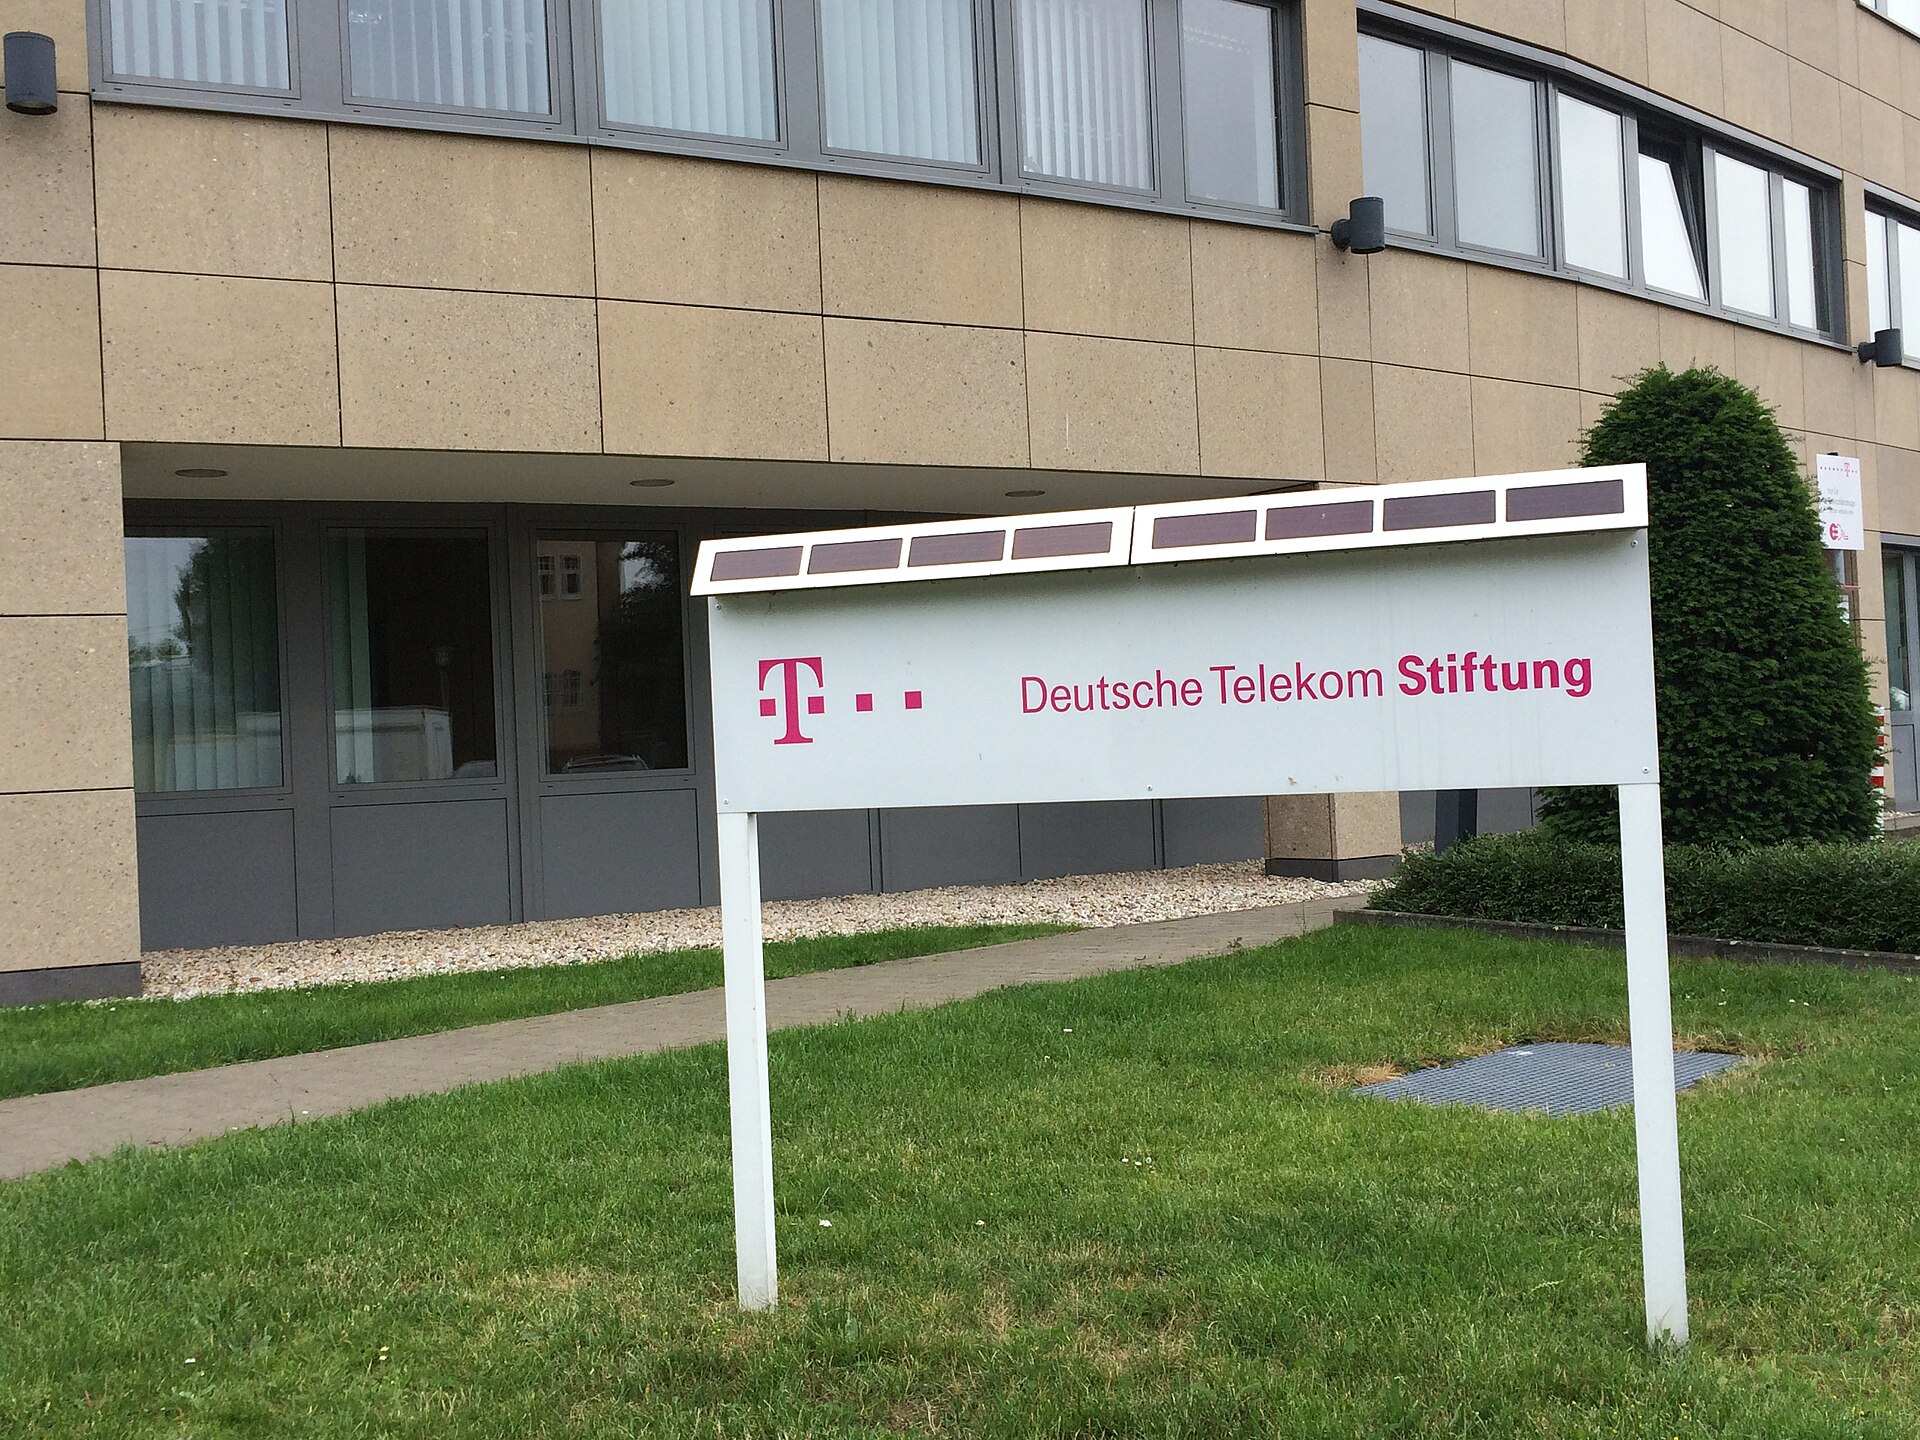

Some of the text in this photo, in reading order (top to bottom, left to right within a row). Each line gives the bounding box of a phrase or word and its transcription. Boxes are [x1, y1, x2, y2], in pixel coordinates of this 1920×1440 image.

[758, 656, 825, 745] T
[1021, 651, 1593, 714] Deutsche Telekom Stiftung
